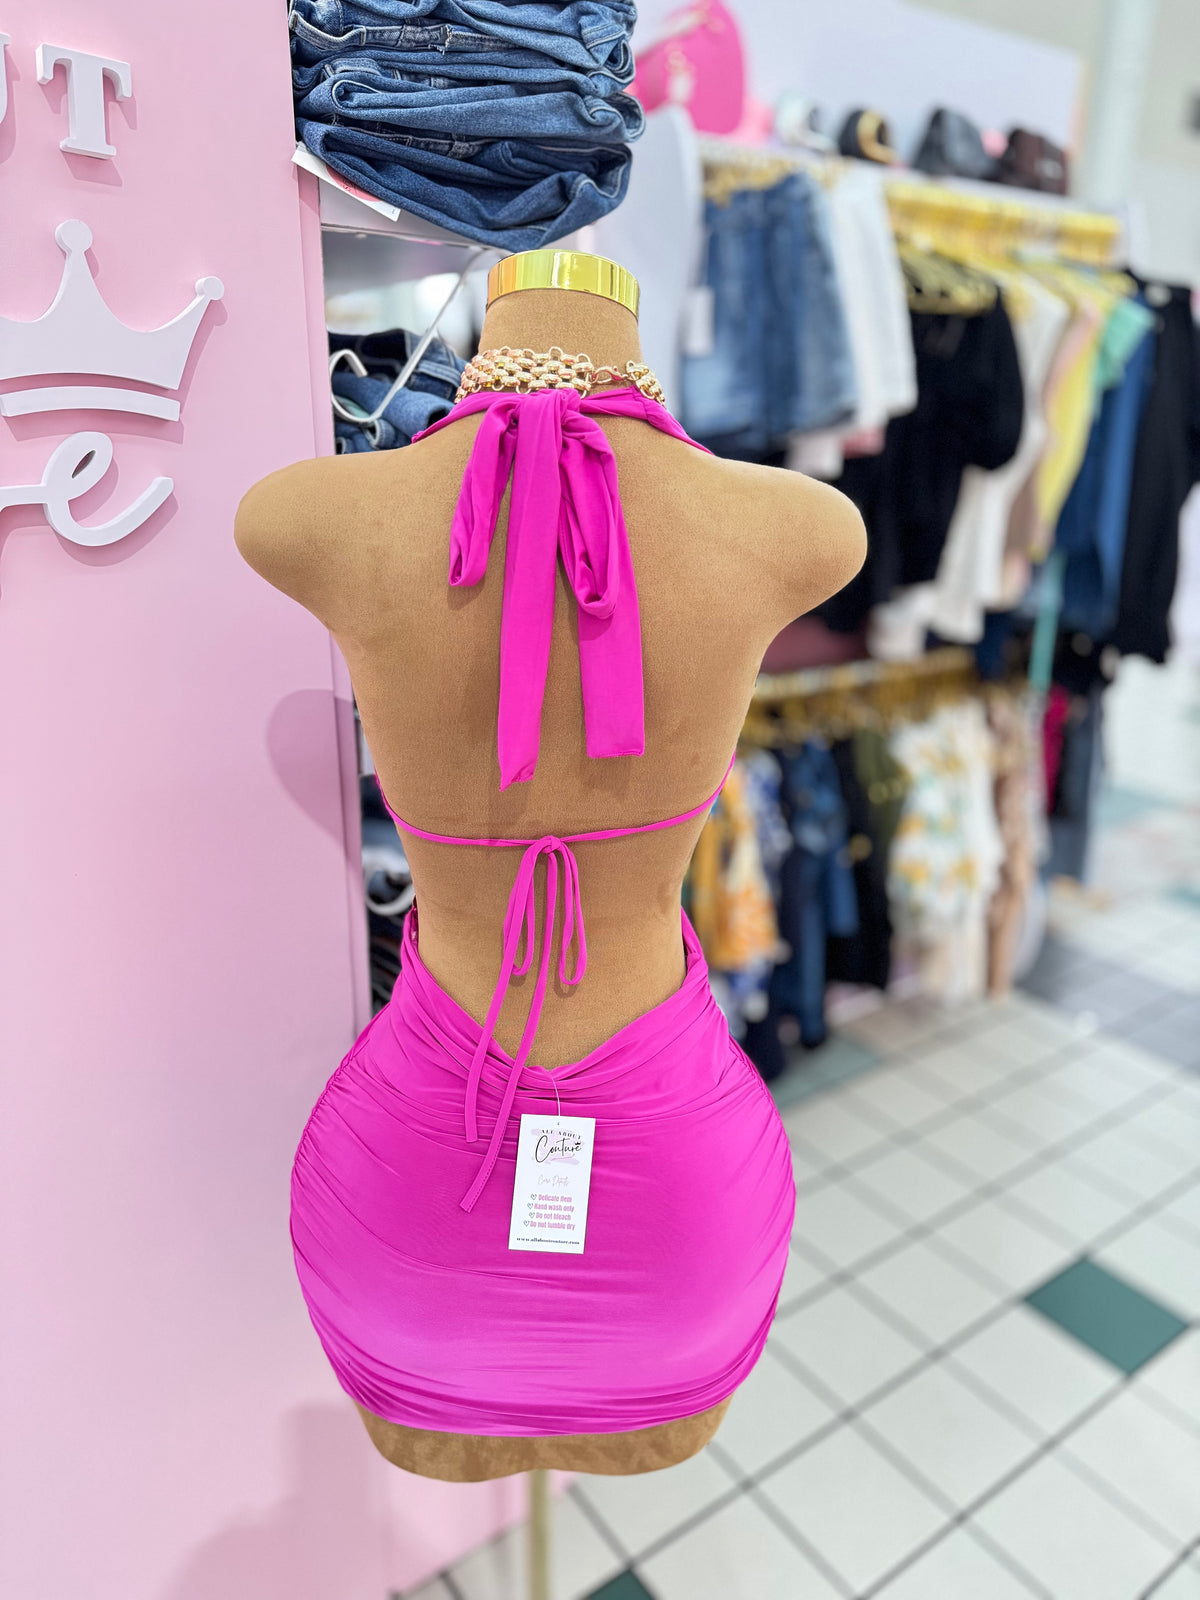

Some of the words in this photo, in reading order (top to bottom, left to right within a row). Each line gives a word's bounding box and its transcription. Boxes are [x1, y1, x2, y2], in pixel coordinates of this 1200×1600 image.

[558, 1131, 582, 1140] ABOUT
[535, 1134, 582, 1163] Couture
[538, 1194, 559, 1202] Delicate
[553, 1213, 571, 1221] bleach
[547, 1221, 566, 1229] tumble
